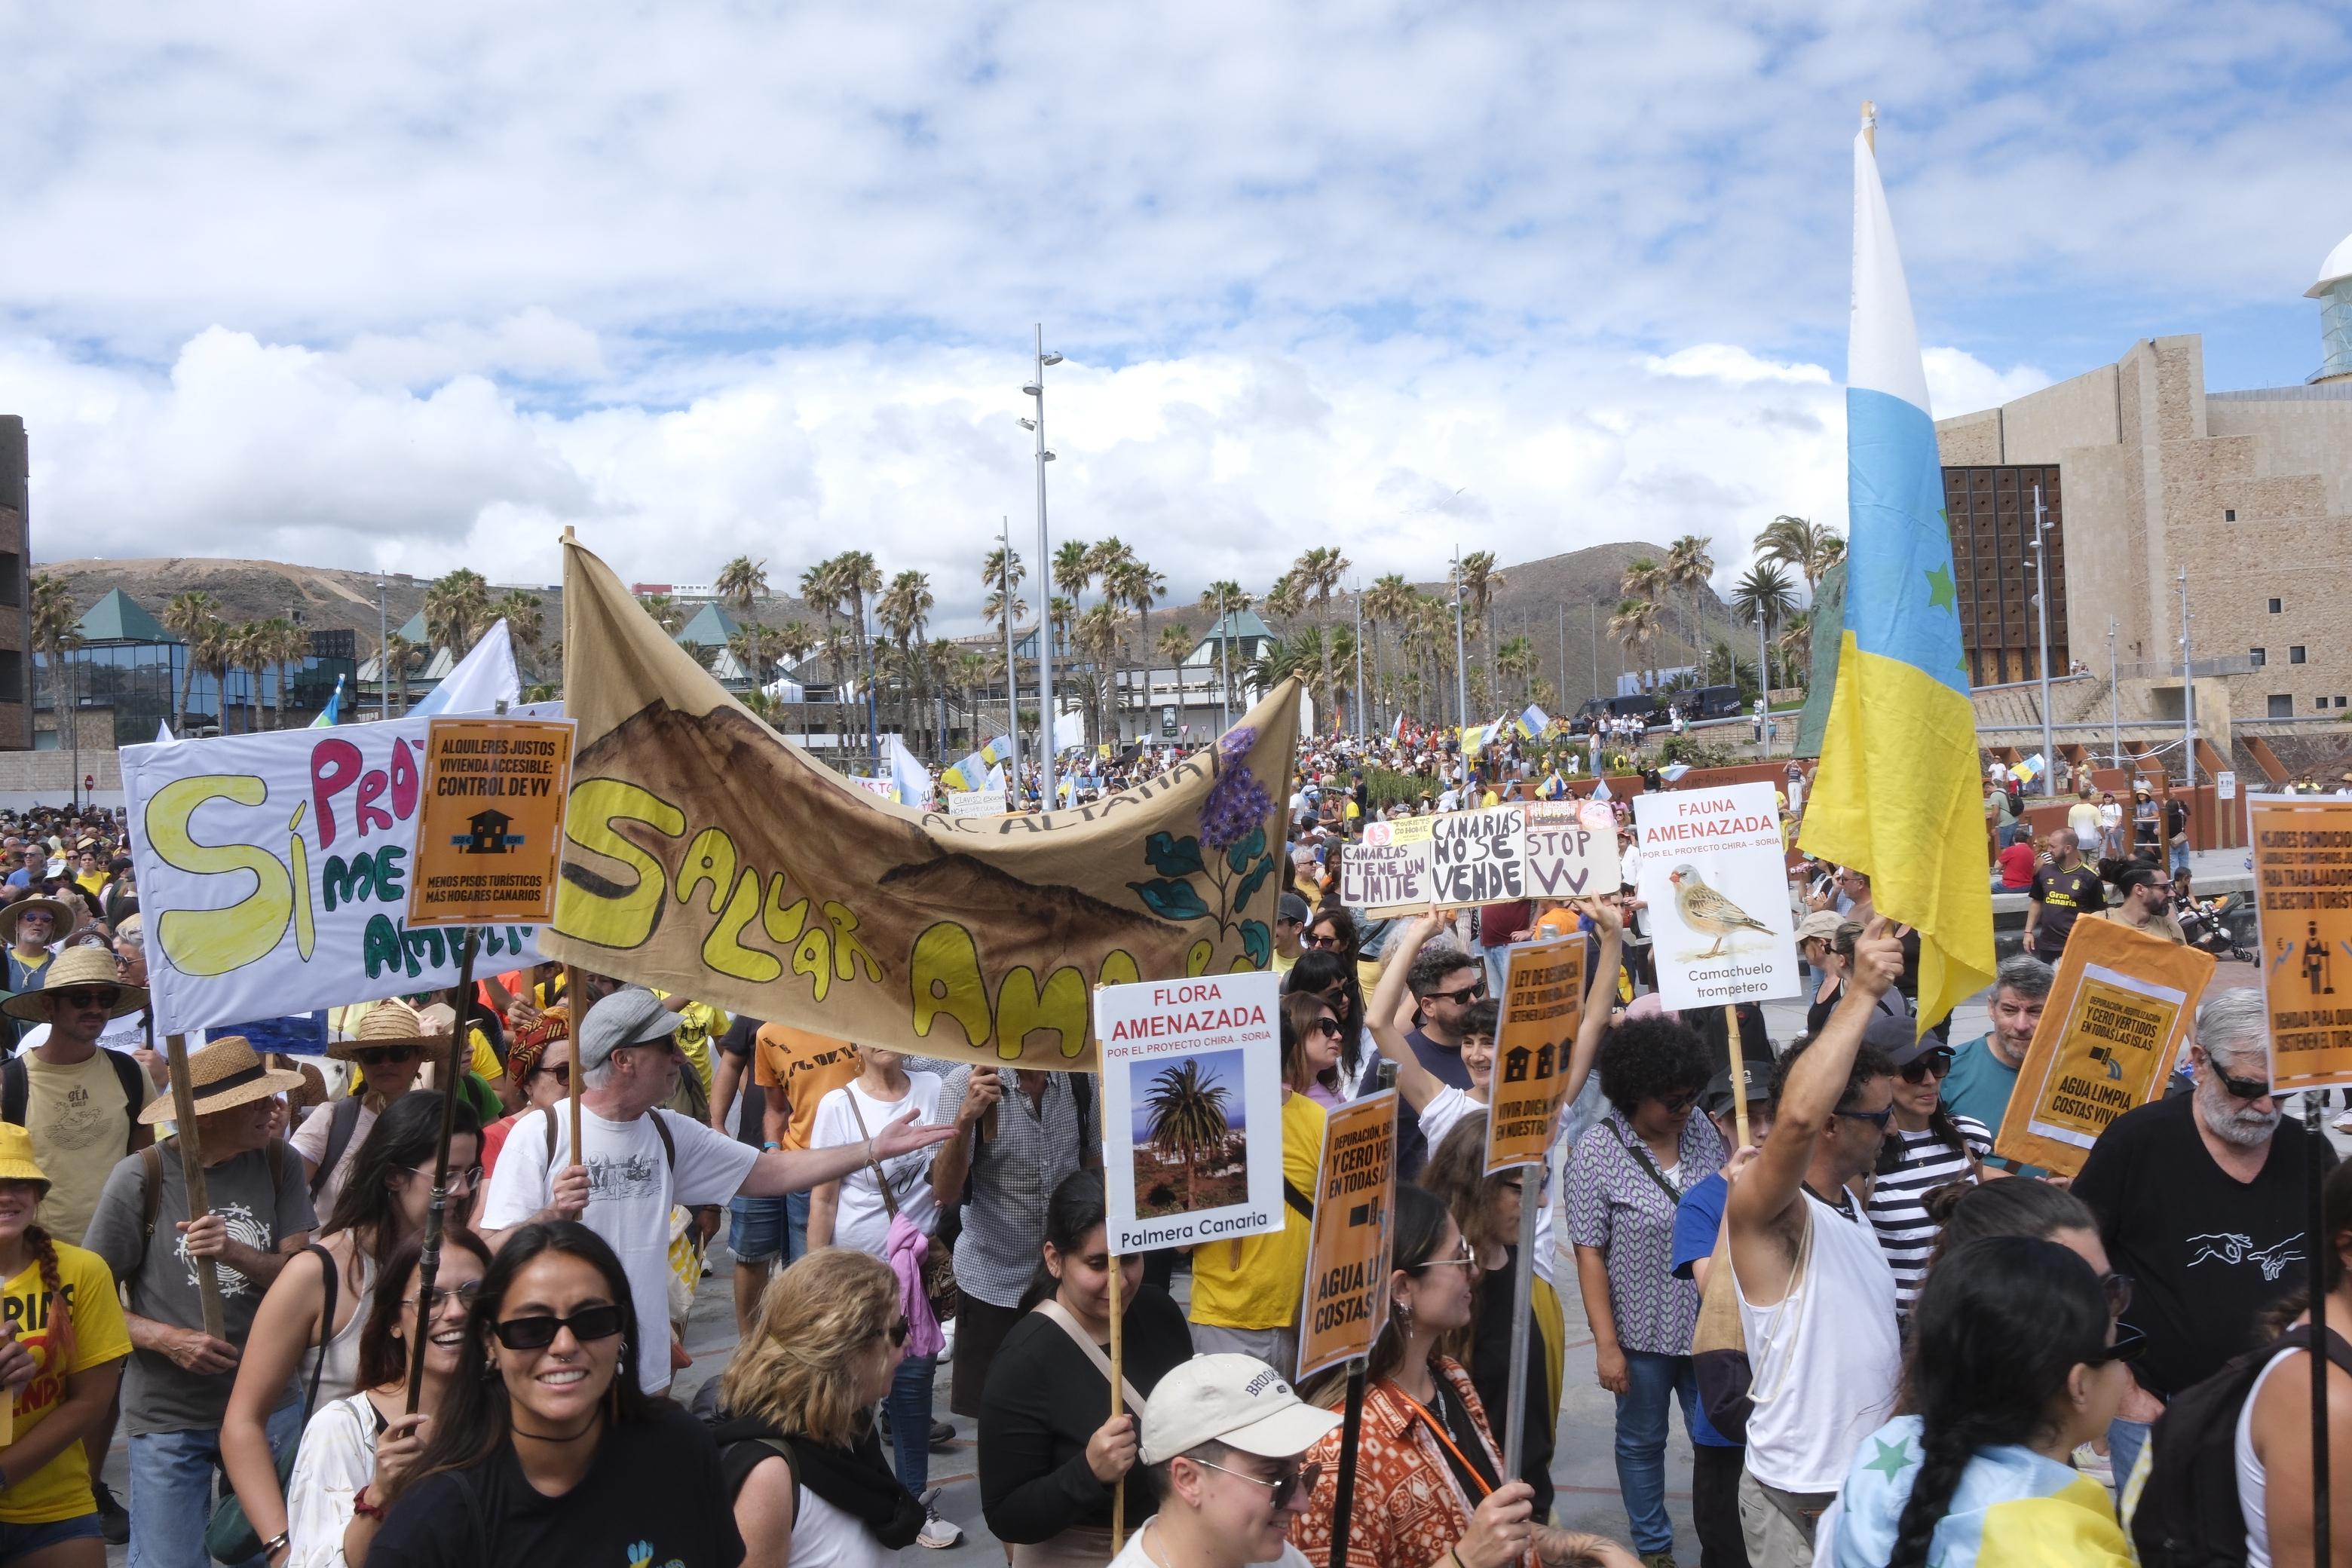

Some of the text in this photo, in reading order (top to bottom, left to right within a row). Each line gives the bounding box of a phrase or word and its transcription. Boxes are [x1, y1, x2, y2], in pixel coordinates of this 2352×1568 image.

[441, 739, 556, 756] ALQUILERES JUSTOS
[439, 758, 553, 774] VIVIENDA ACCESIBLE:
[437, 777, 551, 797] CONTROL DE VV
[1554, 807, 1576, 816] POISON
[1679, 799, 1736, 816] FAUNA
[1394, 818, 1430, 828] TOURISTS
[1405, 825, 1428, 834] HOME
[1432, 810, 1521, 841] CANARIAS
[1646, 815, 1774, 843] AMENAZADA
[1343, 844, 1408, 861] CANARIAS
[1435, 834, 1514, 865] NO SE
[1527, 831, 1591, 857] STOP
[1643, 850, 1660, 859] POR
[1663, 849, 1674, 857] EL
[1675, 843, 1720, 856] PROYECTO
[1722, 841, 1747, 850] CHIRA
[1755, 838, 1780, 847] SORIA
[1343, 856, 1425, 876] TIENE UN
[427, 873, 542, 888] MENOS PISOS TURÍSTICOS
[1344, 873, 1419, 902] LIMITE
[1432, 860, 1522, 902] VENDE
[425, 889, 541, 903] MÁS HOGARES CANARIOS
[2045, 896, 2077, 907] Canaria
[2048, 890, 2070, 900] Gran
[1689, 963, 1773, 981] Camachuelo
[1154, 984, 1221, 1006] FLORA
[1697, 982, 1768, 998] trompetero
[1111, 1005, 1266, 1042] AMENAZADA
[2087, 1006, 2158, 1038] Y CERO VERTIDOS
[1107, 1047, 1129, 1058] POR
[1132, 1046, 1144, 1055] EL
[1147, 1039, 1201, 1053] PROYECTO
[1204, 1035, 1234, 1046] CHIRA
[1242, 1031, 1271, 1042] SORIA
[2081, 1021, 2154, 1051] EN TODAS LAS ISLAS
[69, 1089, 88, 1101] SEA
[2058, 1075, 2131, 1110] AGUA LIMPIA
[2052, 1095, 2093, 1120] COSTAS
[1334, 1123, 1381, 1151] DEPURACIÓN,
[1333, 1153, 1340, 1176] Y
[1341, 1144, 1374, 1173] CERO
[1328, 1177, 1342, 1199] EN
[1344, 1166, 1380, 1194] TODAS
[1122, 1211, 1267, 1248] Palmera Canaria
[1317, 1261, 1364, 1303] AGUA
[1315, 1291, 1374, 1334] COSTAS
